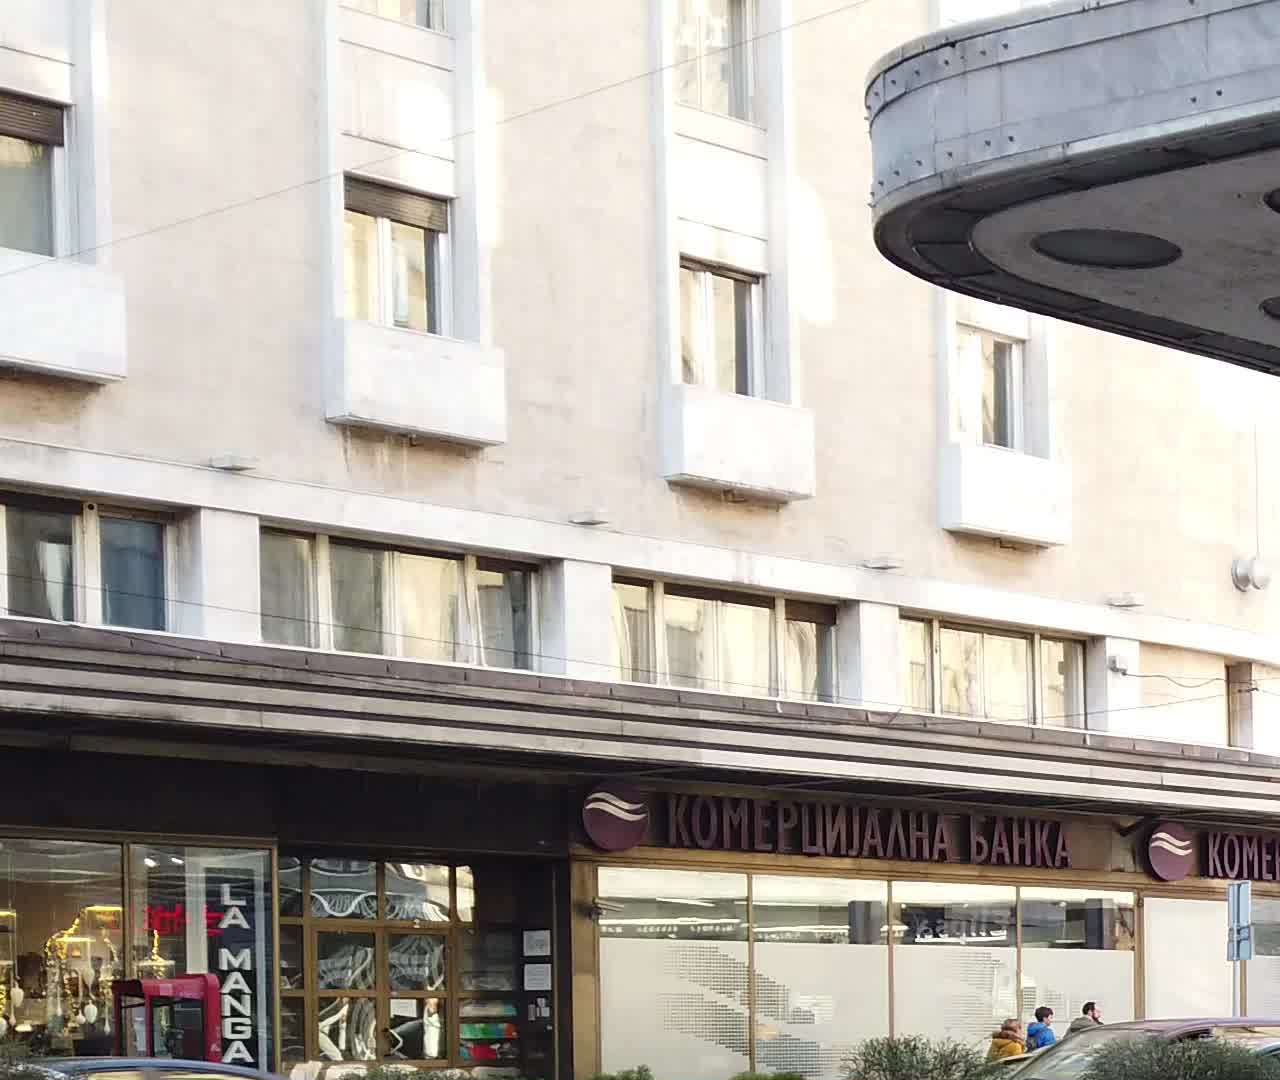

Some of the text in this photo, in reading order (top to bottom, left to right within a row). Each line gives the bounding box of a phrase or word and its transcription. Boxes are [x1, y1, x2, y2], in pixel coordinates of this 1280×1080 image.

[668, 794, 1072, 868] КОМЕРЦИЈАЛНА БАНКА
[217, 883, 255, 1063] LA MANGA
